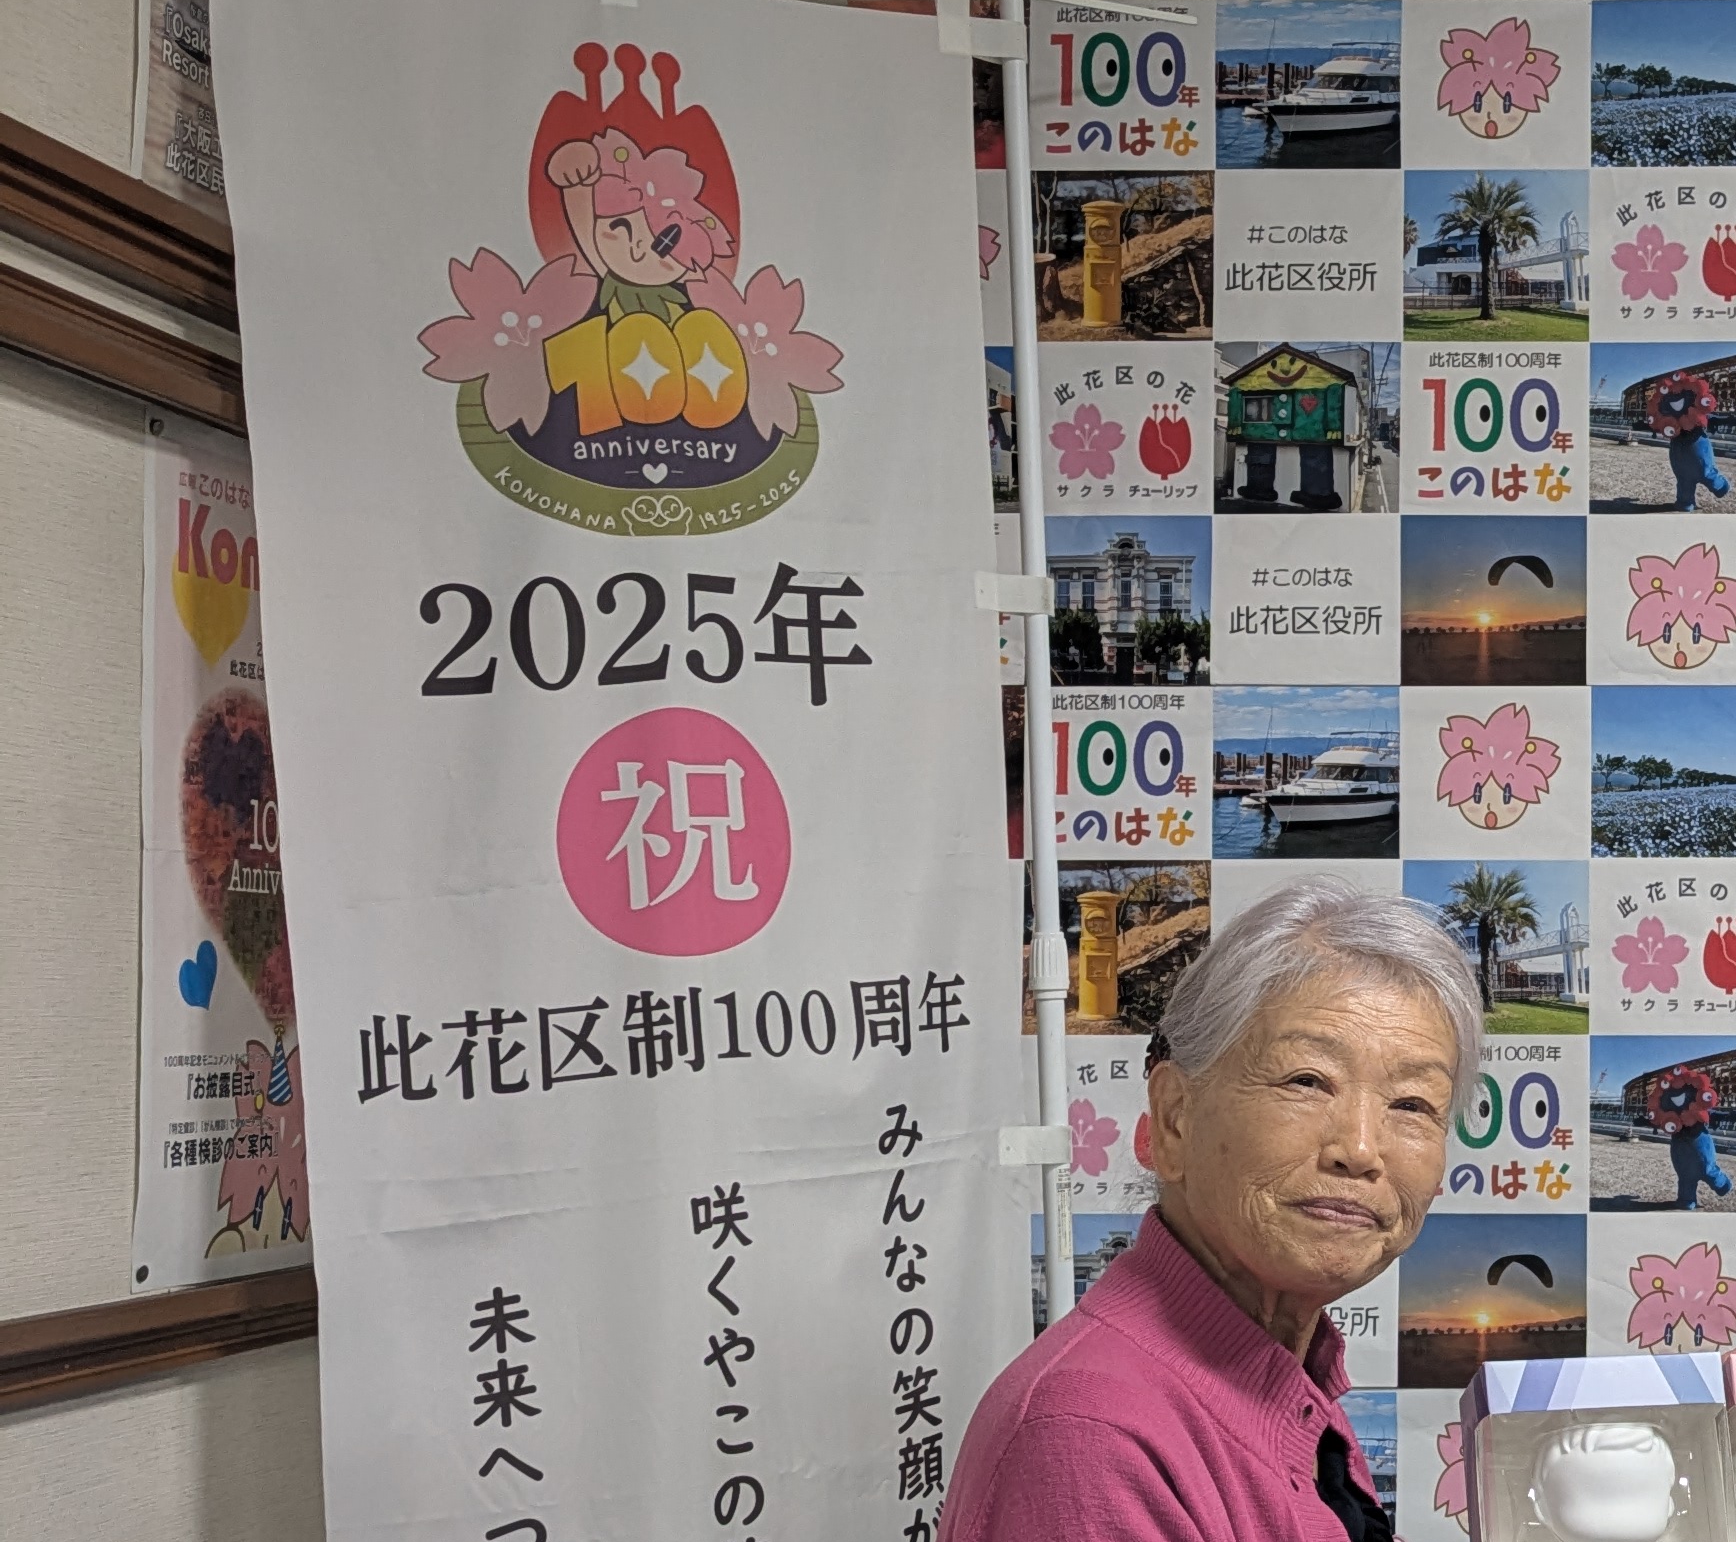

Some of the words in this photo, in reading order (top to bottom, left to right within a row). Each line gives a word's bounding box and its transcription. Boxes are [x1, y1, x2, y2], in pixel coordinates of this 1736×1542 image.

[162, 38, 210, 89] Resort
[1046, 116, 1199, 157] このはな
[1247, 224, 1348, 245] #このはな
[1225, 261, 1377, 293] 此花区役所
[1620, 305, 1678, 320] サクラ
[542, 307, 749, 437] 100
[1428, 351, 1563, 368] 此花区制100周年
[573, 436, 738, 463] anniversary
[493, 465, 617, 531] KONOHANA
[1056, 484, 1115, 499] サクラ
[1128, 483, 1198, 499] チューリップ
[1418, 462, 1573, 504] このはな
[1251, 566, 1353, 588] #このはな
[418, 561, 873, 707] 2025年
[1229, 604, 1383, 637] 此花区役所
[1052, 693, 1186, 711] 此花区制100周年
[600, 759, 760, 910] 祝
[228, 858, 284, 896] Anniv
[1620, 998, 1679, 1013] サクラ
[357, 970, 971, 1105] 此花区制100周年
